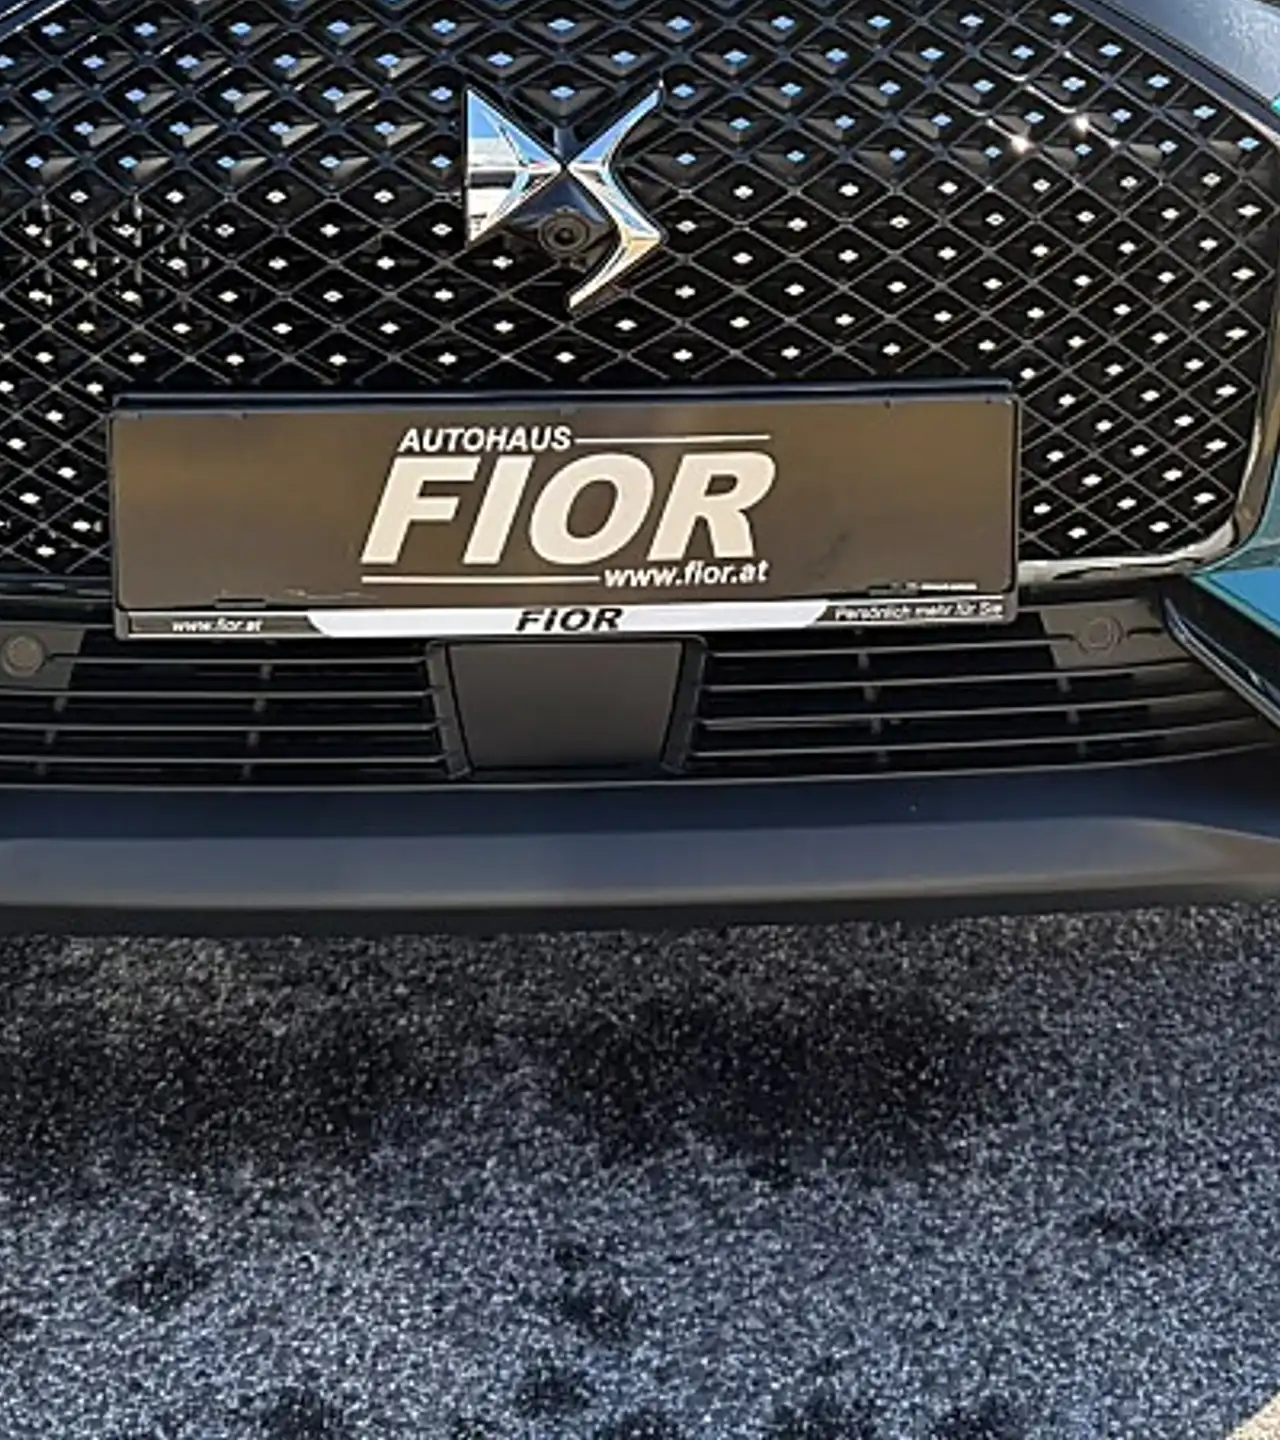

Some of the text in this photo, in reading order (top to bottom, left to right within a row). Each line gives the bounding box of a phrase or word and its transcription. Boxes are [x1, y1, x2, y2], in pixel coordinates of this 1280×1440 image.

[398, 426, 572, 452] AUTOHAUS
[360, 452, 776, 564] FIOR
[604, 560, 768, 587] www.fior.at
[515, 607, 624, 632] FIOR
